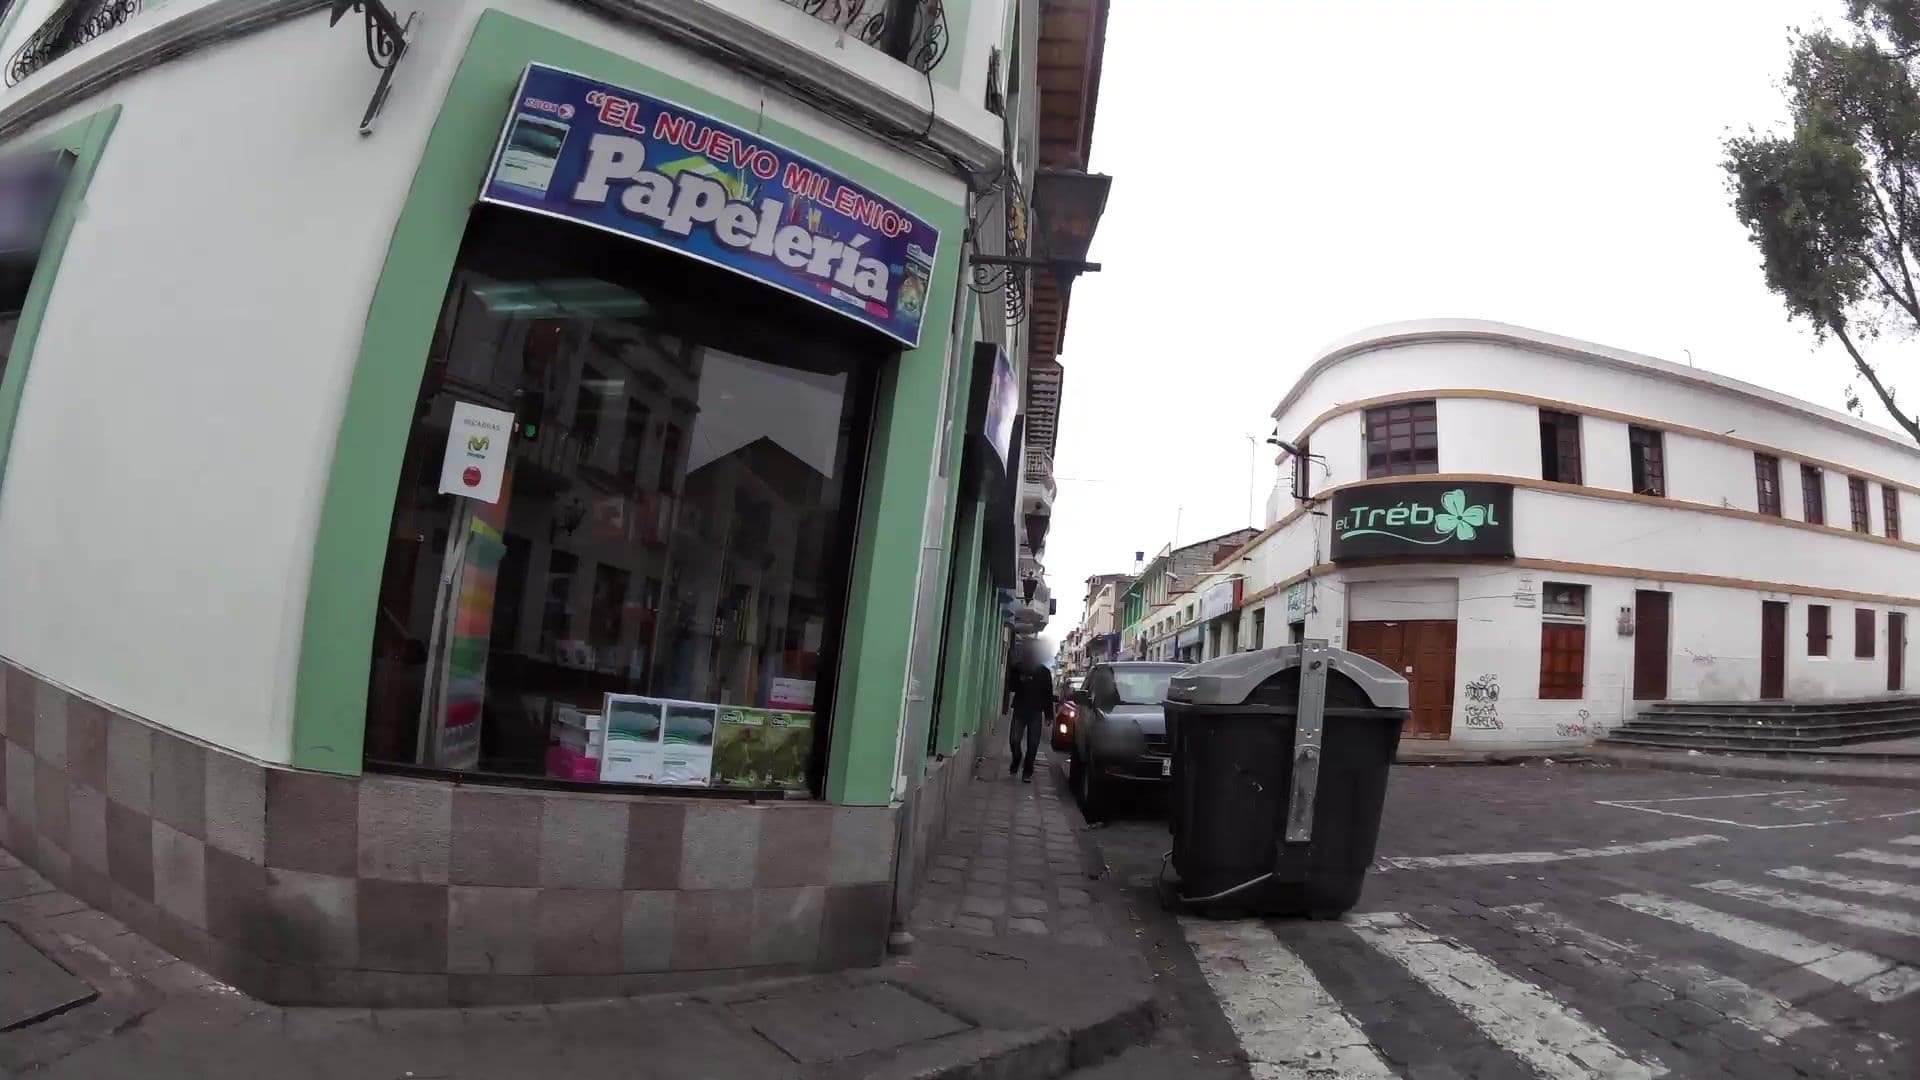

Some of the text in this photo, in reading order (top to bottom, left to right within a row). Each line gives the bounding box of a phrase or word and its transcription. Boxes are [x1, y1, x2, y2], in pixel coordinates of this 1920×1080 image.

[655, 111, 779, 180] NUEVO
[572, 131, 890, 303] Papelería
[1350, 488, 1500, 541] Trébl
